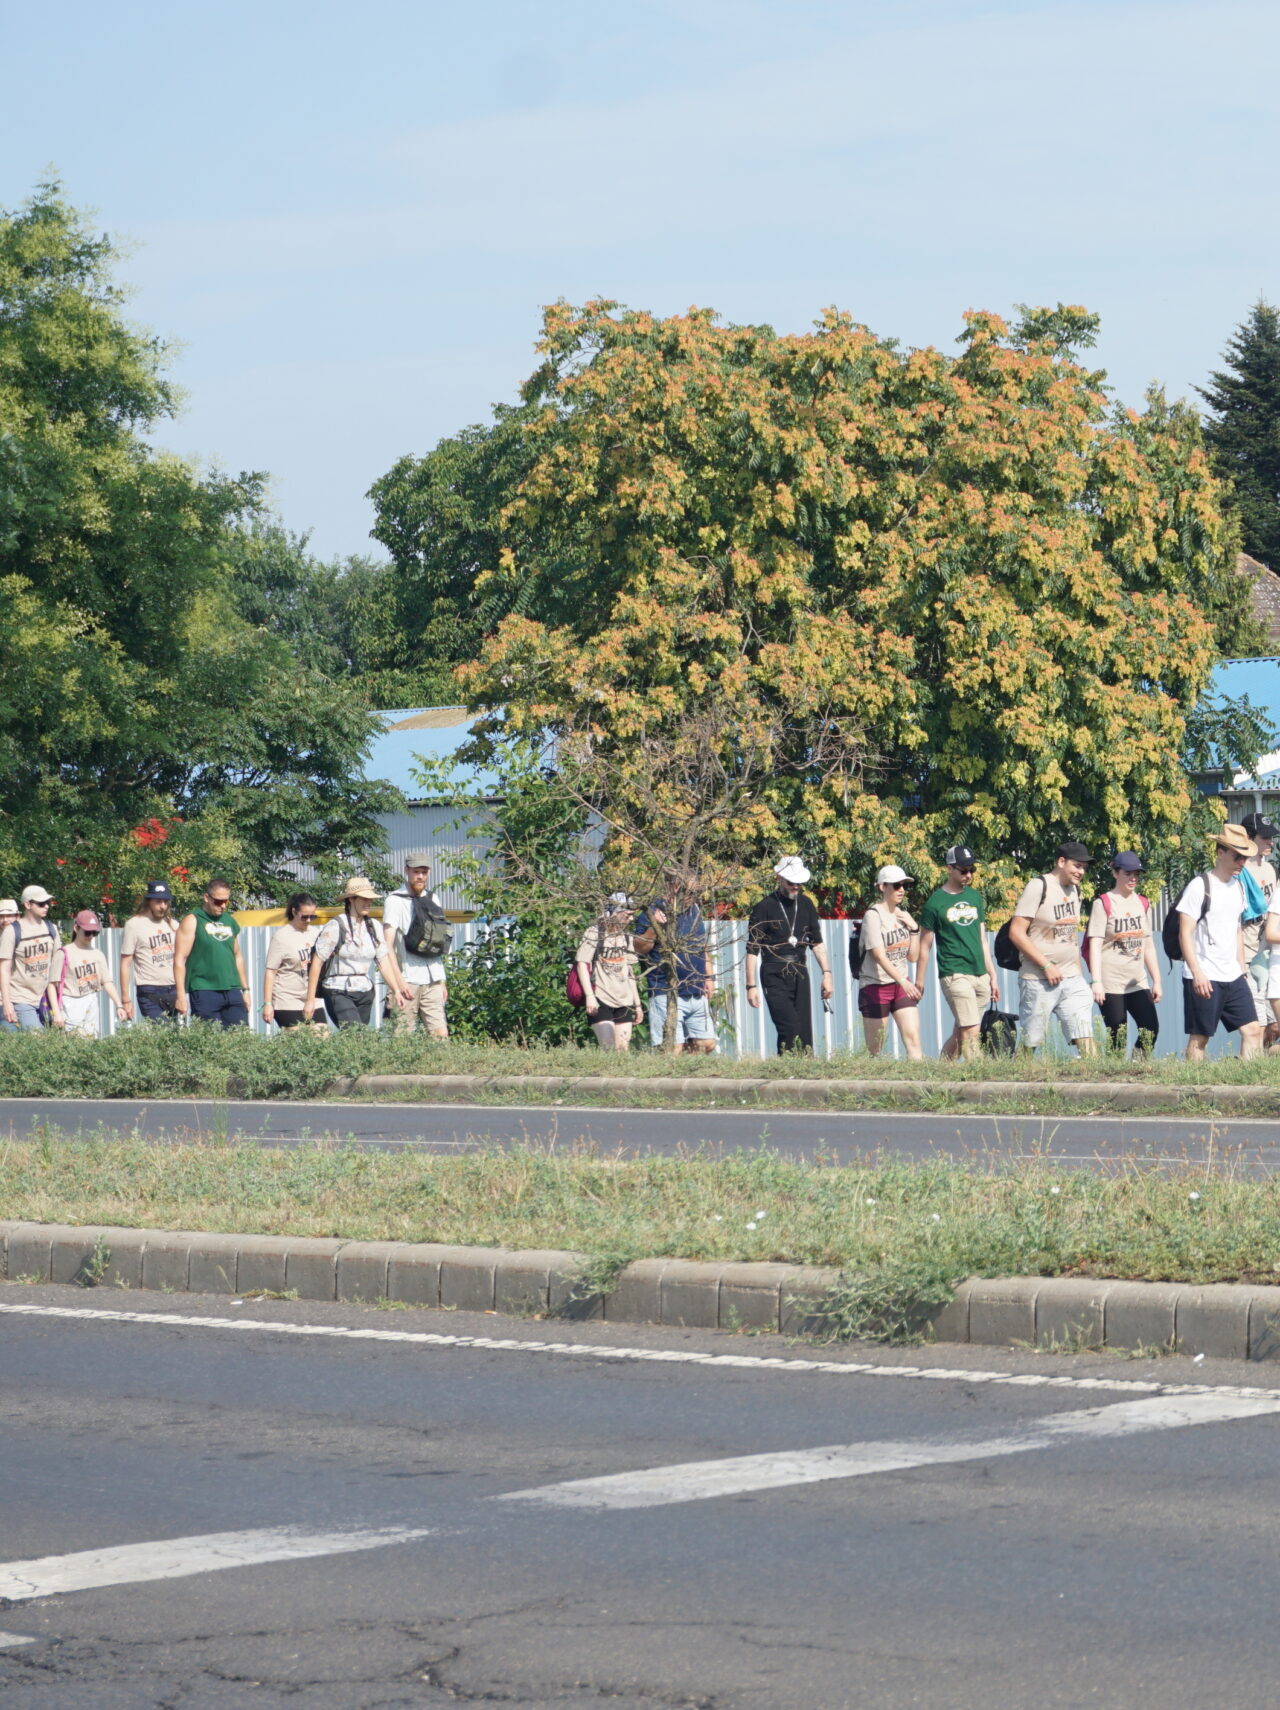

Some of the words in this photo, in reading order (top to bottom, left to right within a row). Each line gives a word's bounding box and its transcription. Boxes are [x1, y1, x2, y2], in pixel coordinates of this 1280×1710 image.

[1053, 901, 1075, 920] UTAT
[1114, 916, 1142, 933] UTAT
[149, 932, 172, 948] UTAT
[24, 942, 48, 958] UTAT
[74, 962, 97, 979] UTAT
